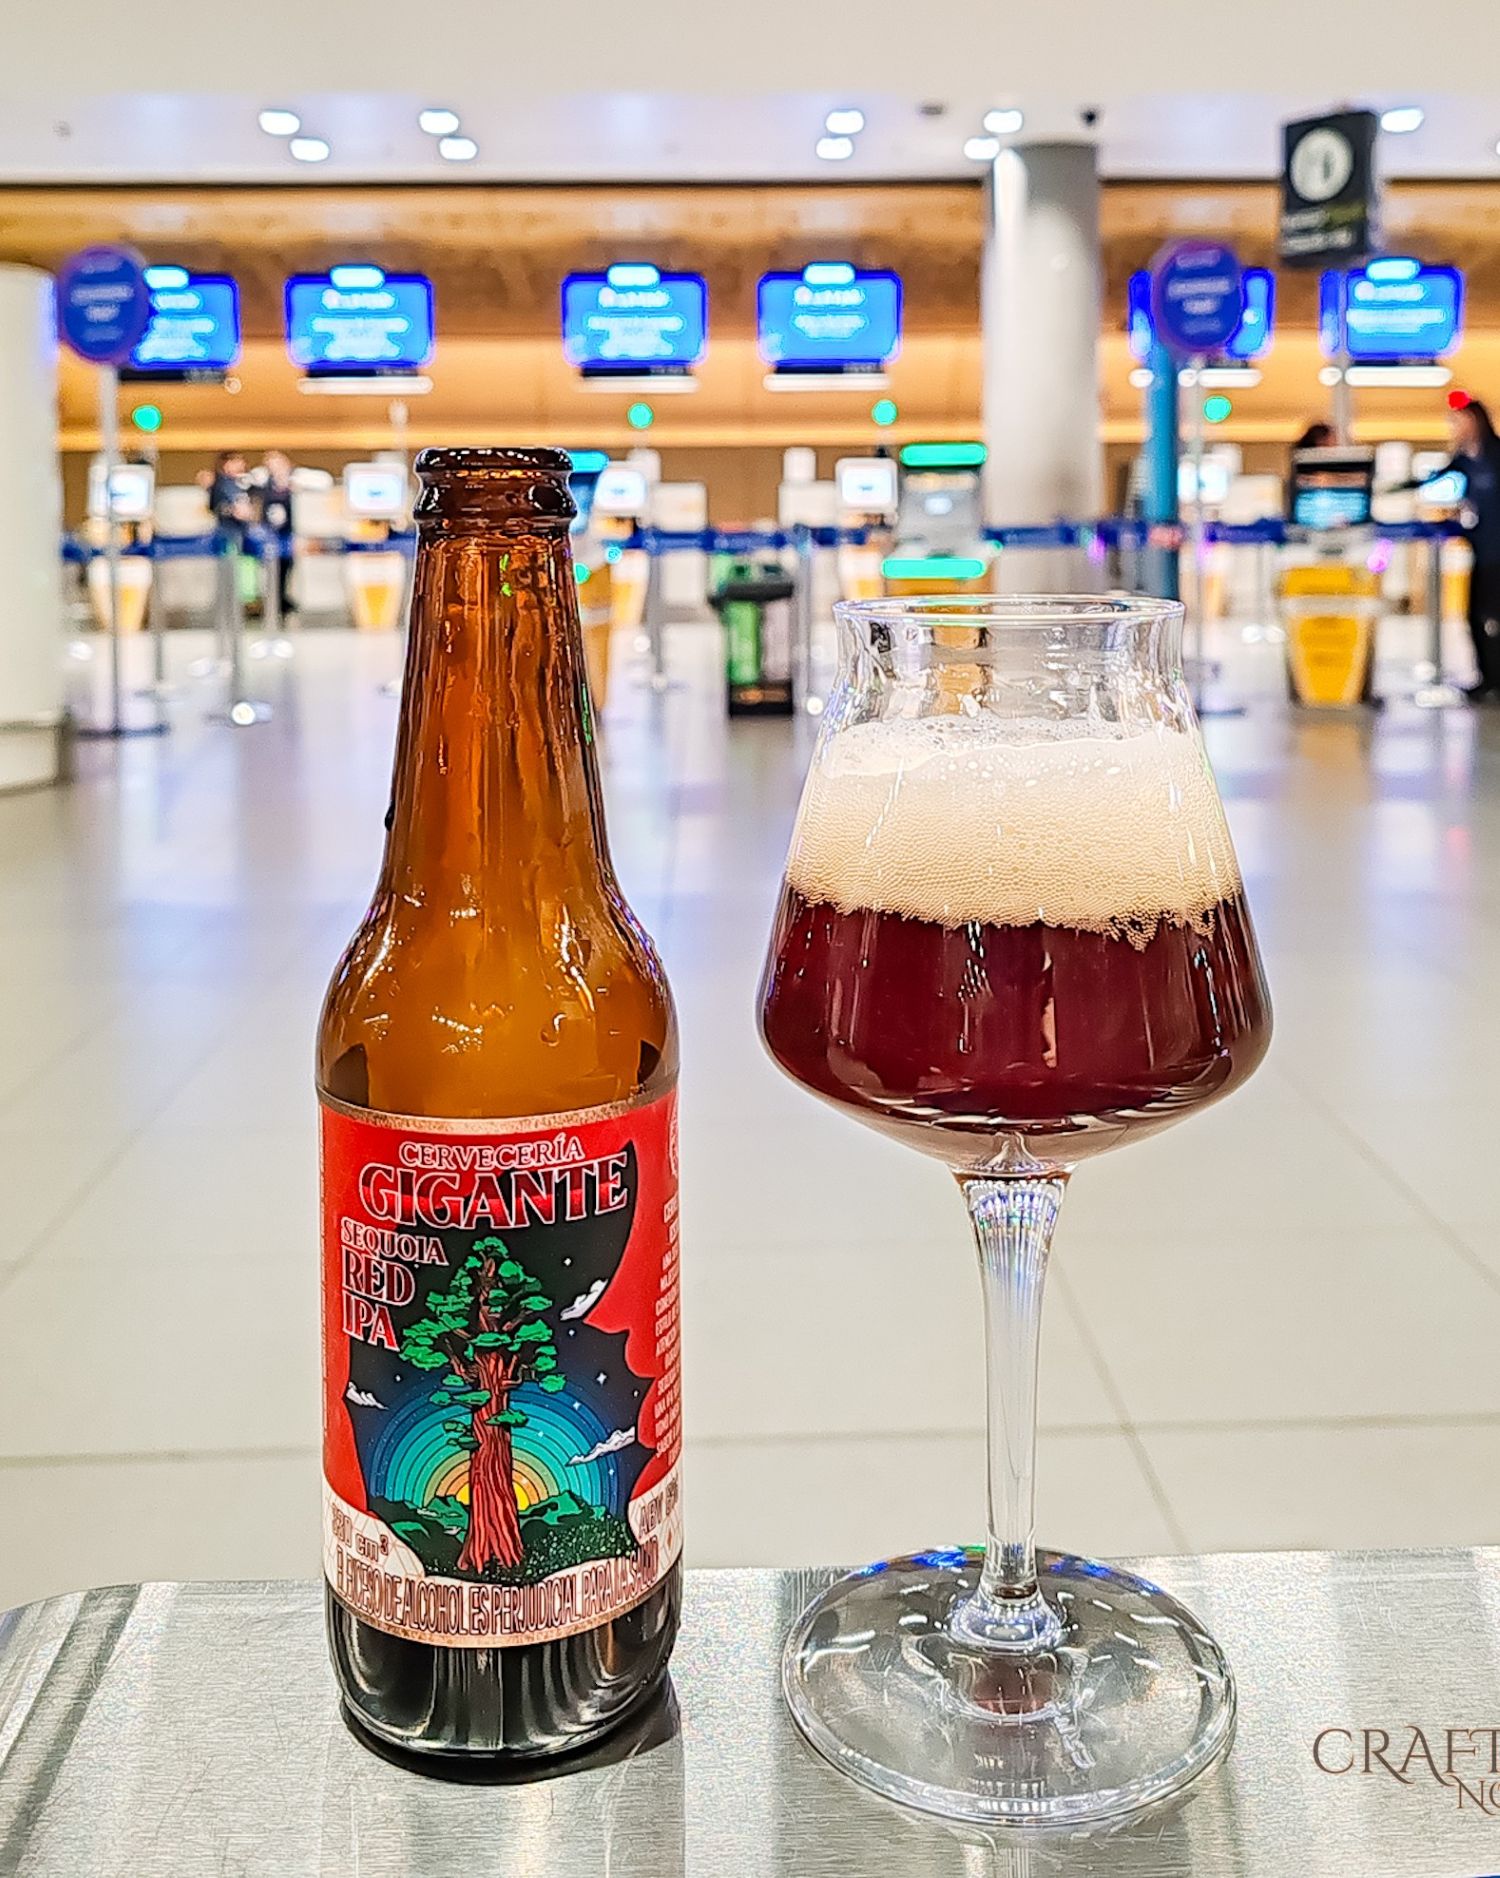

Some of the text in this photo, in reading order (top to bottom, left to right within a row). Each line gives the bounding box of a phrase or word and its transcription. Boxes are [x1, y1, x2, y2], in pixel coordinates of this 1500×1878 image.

[401, 1132, 585, 1171] CERVECERÍA
[360, 1152, 628, 1229] GIGANTE
[342, 1217, 449, 1266] SEQUOIA
[342, 1245, 415, 1306] RED
[342, 1290, 400, 1351] IPA
[384, 1567, 403, 1625] DE
[398, 1572, 468, 1637] ALCOHOL
[469, 1586, 490, 1636] ES
[491, 1573, 581, 1635] PERJUDICIAL
[582, 1560, 614, 1619] PARA
